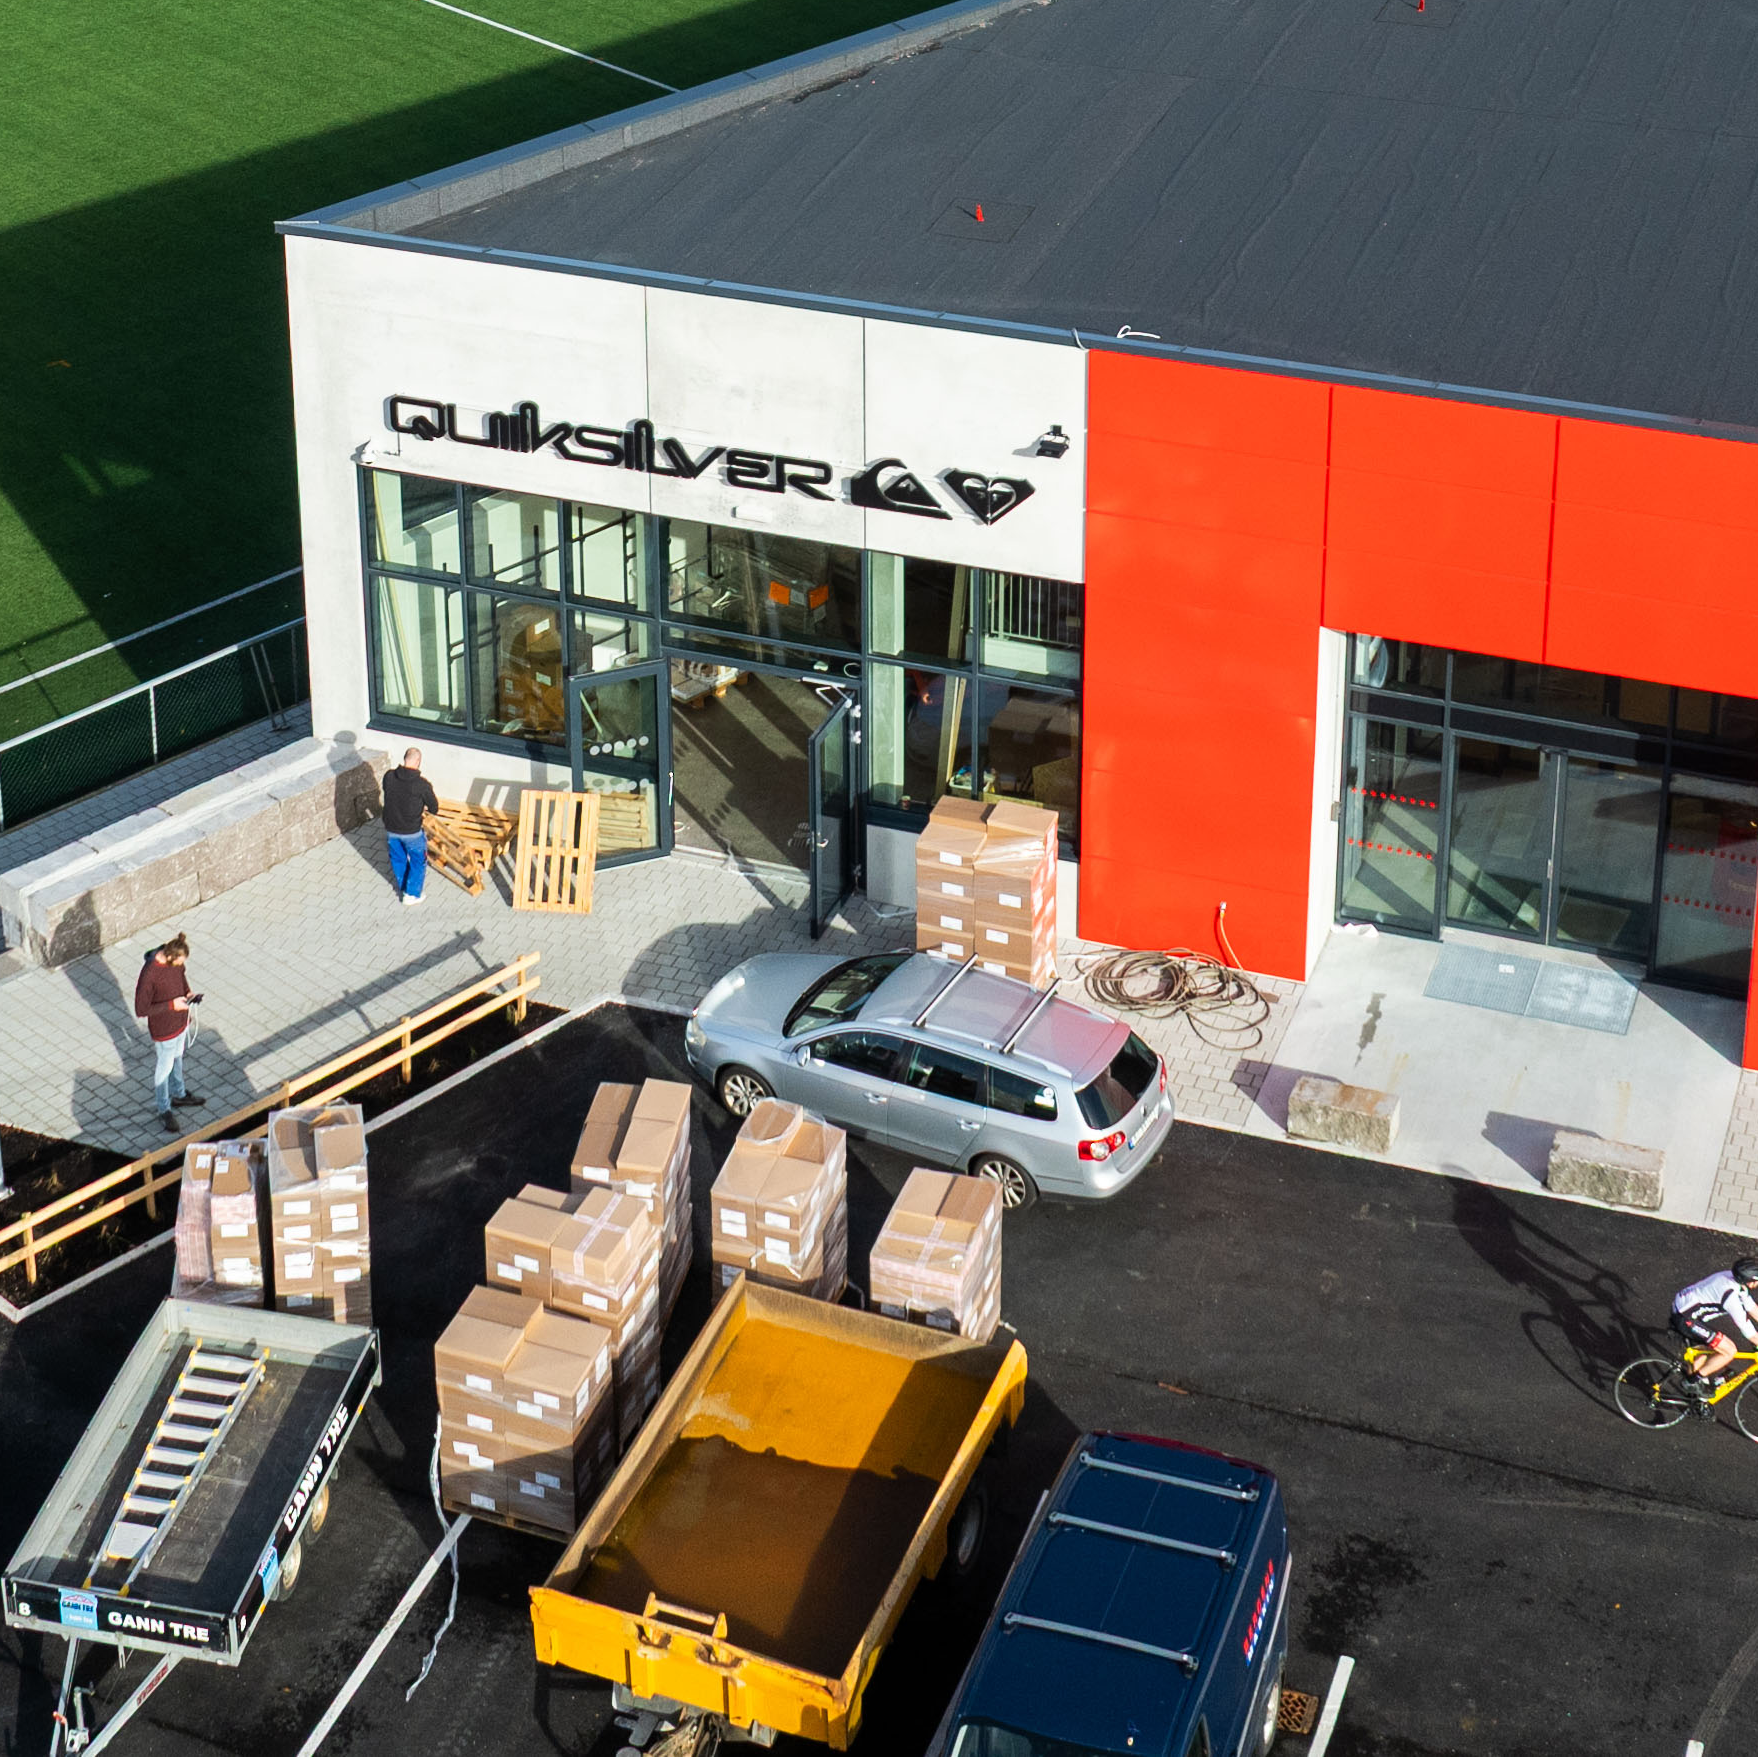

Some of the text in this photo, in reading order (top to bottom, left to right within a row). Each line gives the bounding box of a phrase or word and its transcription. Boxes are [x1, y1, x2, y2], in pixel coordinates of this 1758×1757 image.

[283, 1402, 349, 1532] GANN TRE
[18, 1601, 31, 1617] 8
[108, 1611, 165, 1634] GANN
[169, 1622, 210, 1642] TRE
